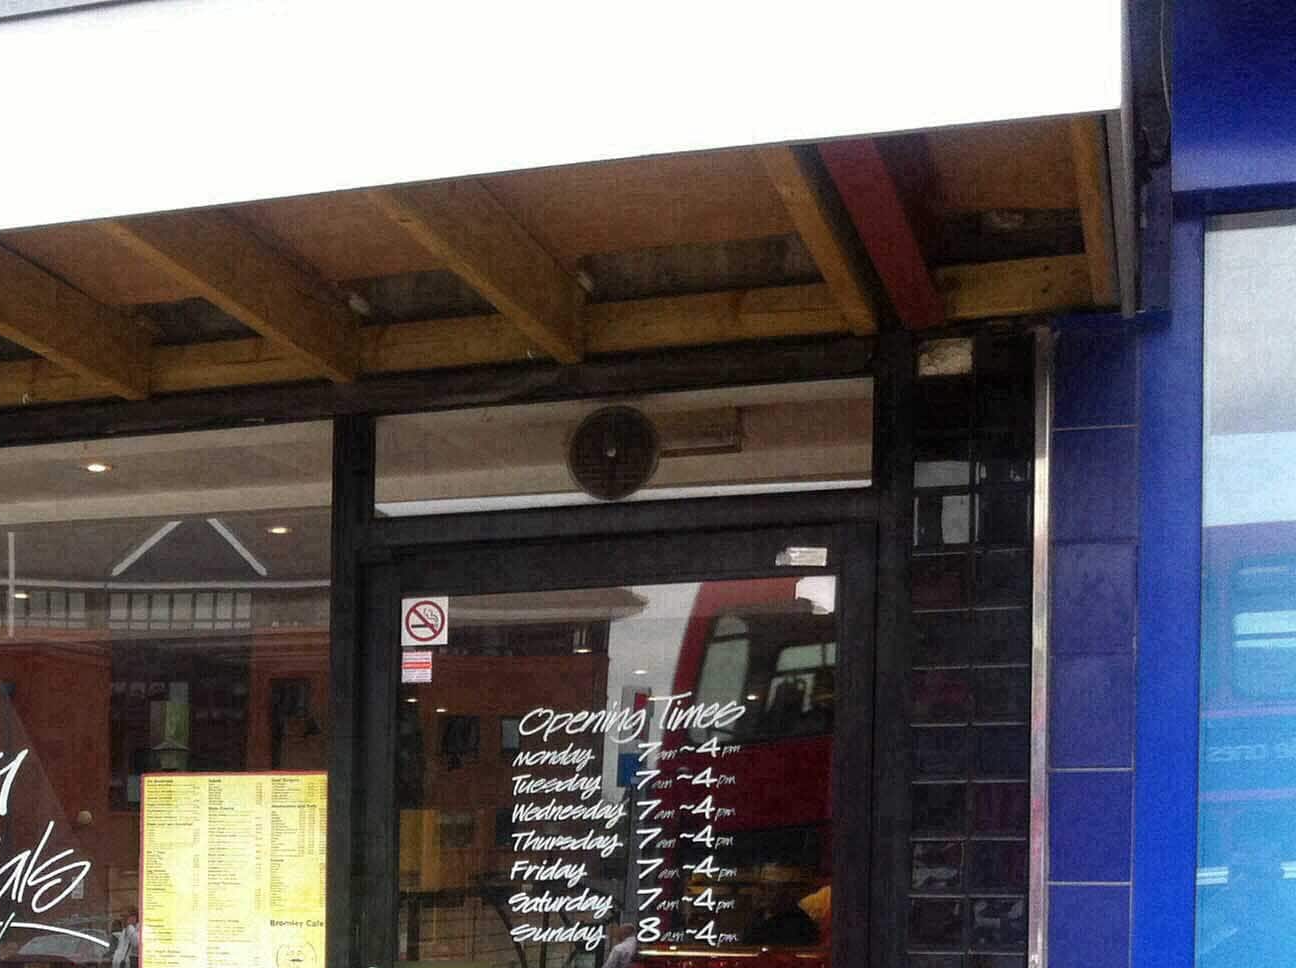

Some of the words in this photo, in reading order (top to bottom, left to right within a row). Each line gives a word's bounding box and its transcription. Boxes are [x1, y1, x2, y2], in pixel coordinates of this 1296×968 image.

[518, 701, 646, 744] Opening
[648, 691, 745, 731] Times
[512, 743, 595, 771] Monday
[512, 773, 601, 800] Tuesday
[512, 798, 626, 829] Wednesday
[512, 830, 623, 857] Thursday
[510, 859, 587, 888] Friday
[509, 891, 613, 919] Saturday
[510, 923, 607, 950] Sunday
